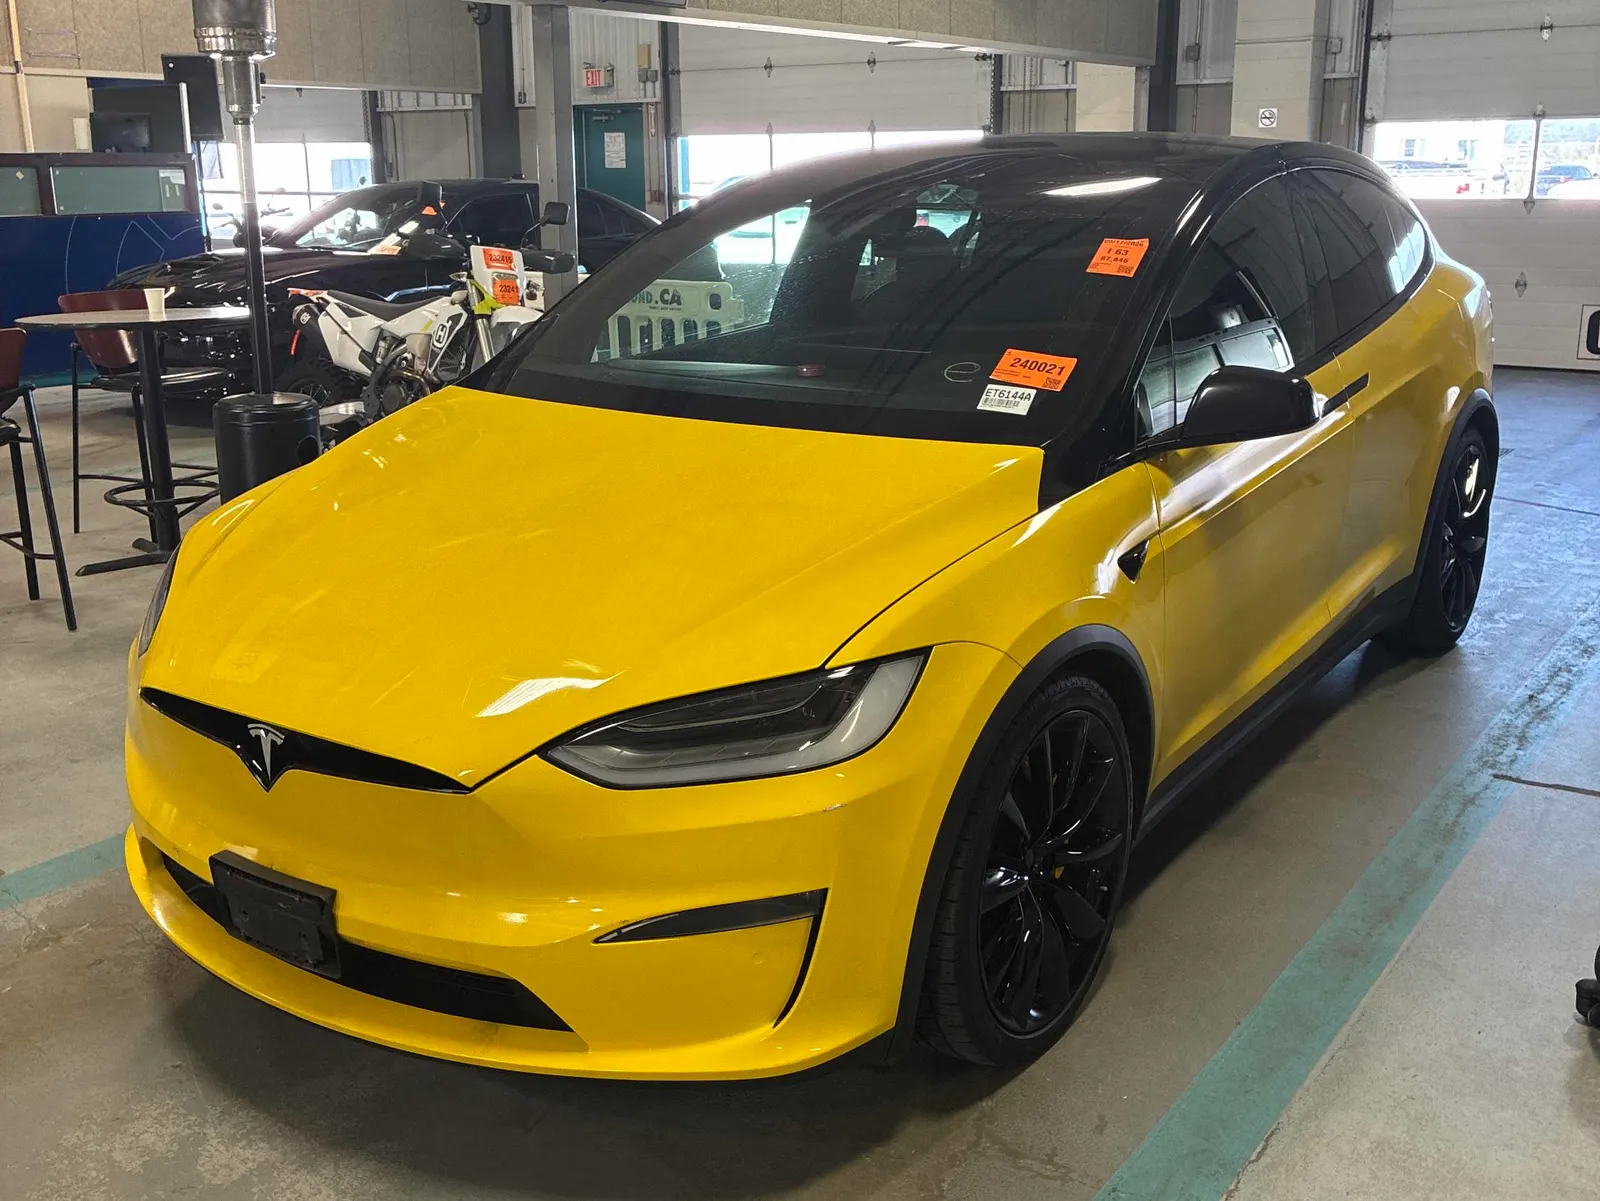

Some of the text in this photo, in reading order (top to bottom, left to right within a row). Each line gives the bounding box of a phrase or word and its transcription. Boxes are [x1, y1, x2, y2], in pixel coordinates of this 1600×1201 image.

[586, 70, 601, 86] EXIT
[1010, 358, 1065, 376] 240021
[984, 388, 1031, 401] ET6144A
